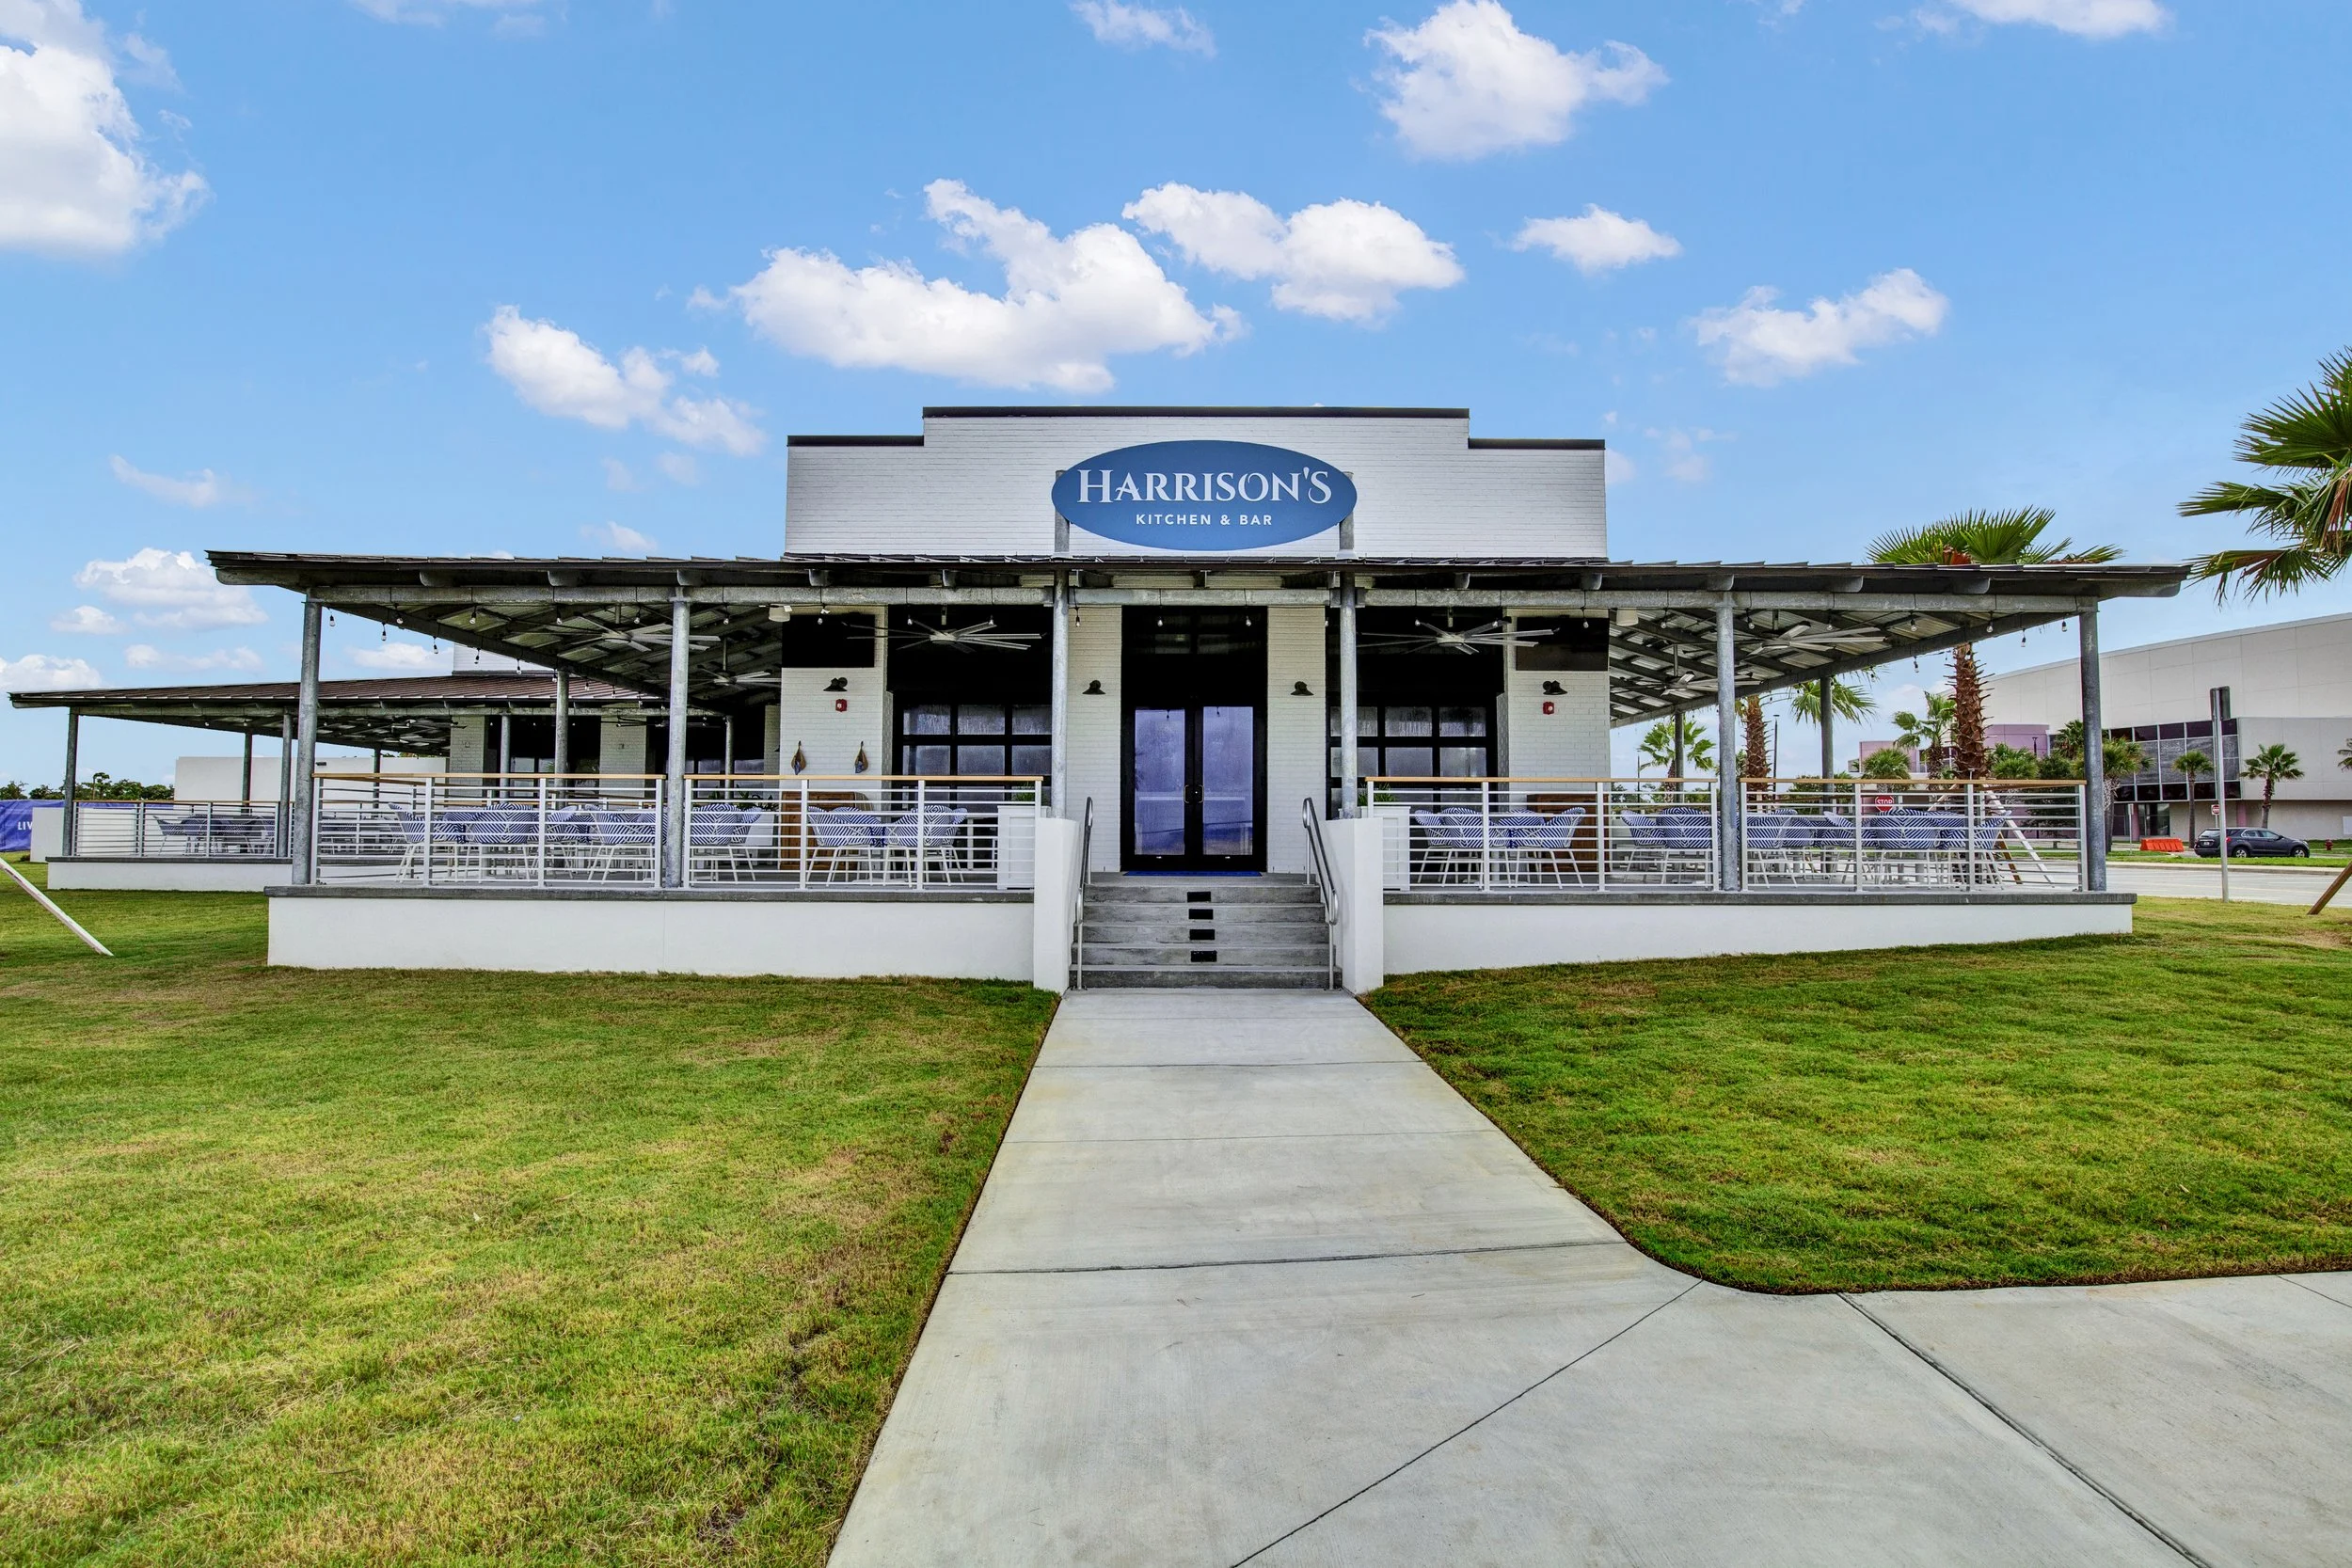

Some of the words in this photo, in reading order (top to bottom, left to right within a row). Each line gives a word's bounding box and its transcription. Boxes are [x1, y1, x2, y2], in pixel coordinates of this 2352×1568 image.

[1077, 467, 1331, 504] HARRISON'S
[1136, 514, 1211, 525] KITCHEN
[1219, 514, 1231, 526] &
[1239, 515, 1272, 526] BAR
